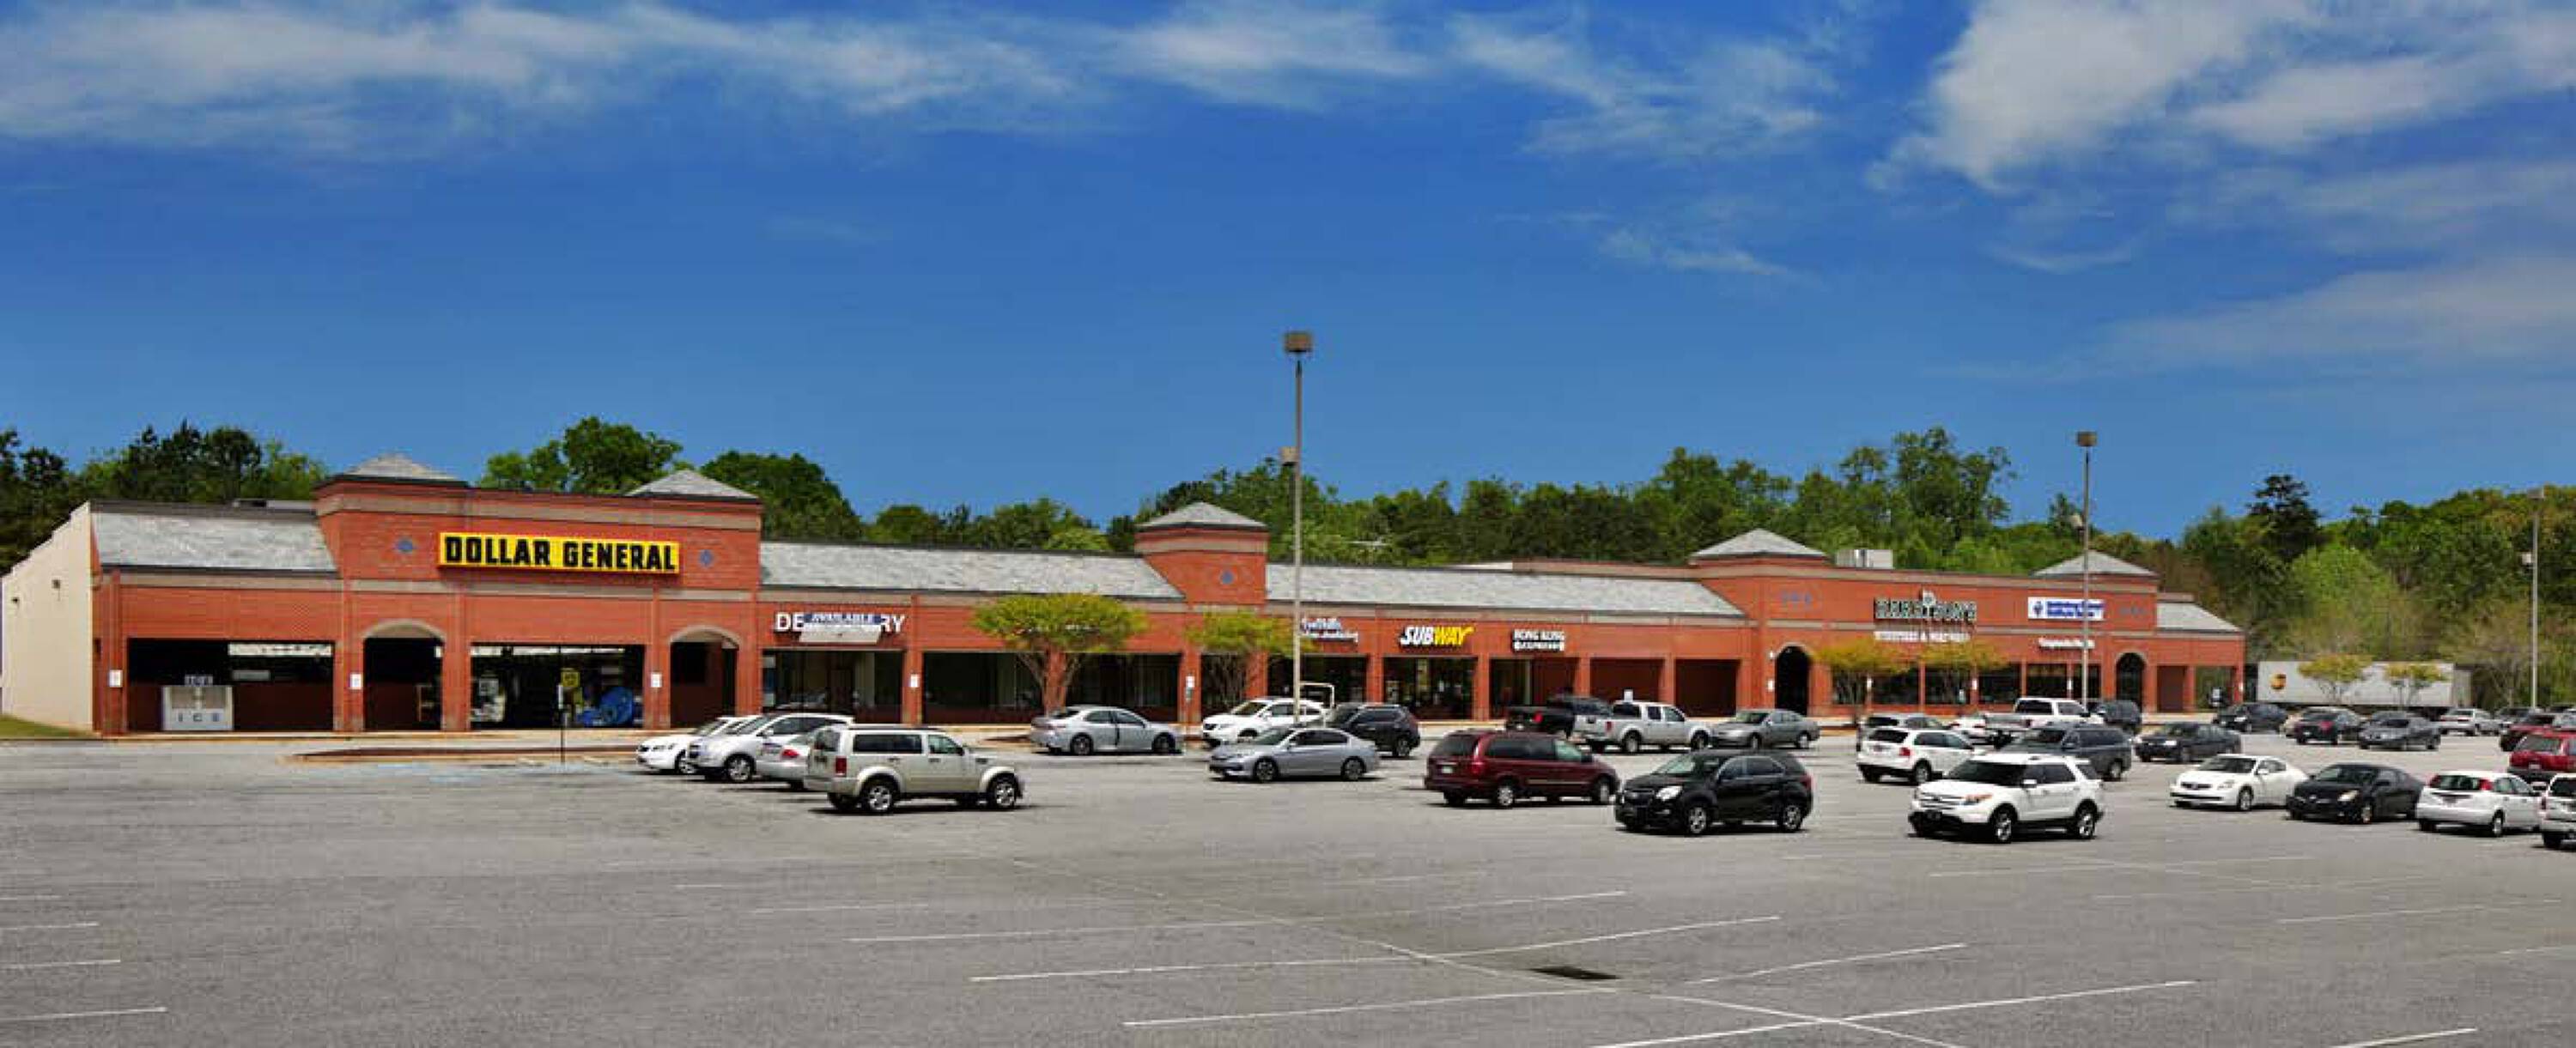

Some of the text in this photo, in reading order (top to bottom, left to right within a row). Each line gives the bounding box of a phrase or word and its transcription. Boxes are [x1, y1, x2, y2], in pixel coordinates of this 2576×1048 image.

[444, 536, 676, 570] DOLLAR GENERAL
[1400, 625, 1475, 645] SUBWAY
